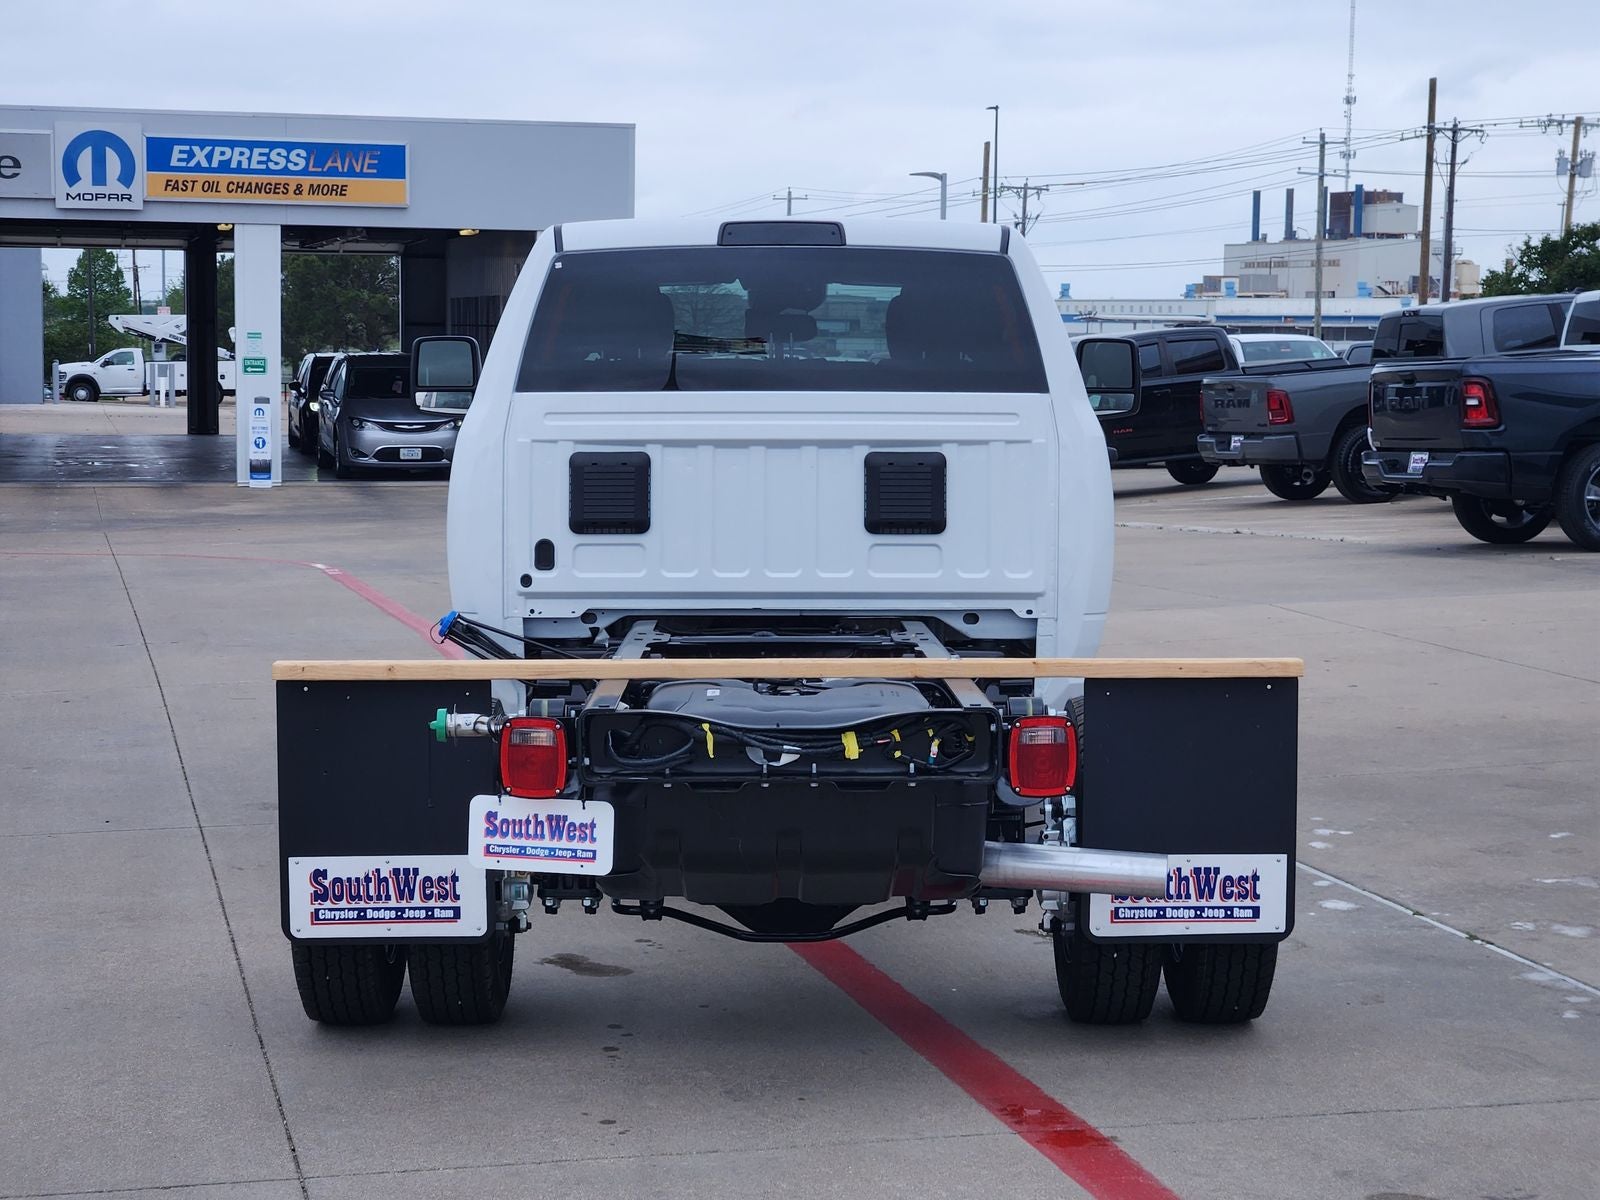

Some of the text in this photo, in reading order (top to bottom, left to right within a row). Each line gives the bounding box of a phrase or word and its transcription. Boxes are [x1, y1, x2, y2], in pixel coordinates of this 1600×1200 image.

[164, 179, 348, 197] FAST OIL CHANGES & MORE
[66, 192, 134, 203] MOPAR
[1214, 398, 1251, 409] RAM
[489, 844, 593, 858] Chrysler Dodge Jeep Ram
[318, 908, 454, 920] Chrysler Dodge Jeep Ram
[1118, 907, 1253, 919] Chrysler Dodge Jeep Ram
